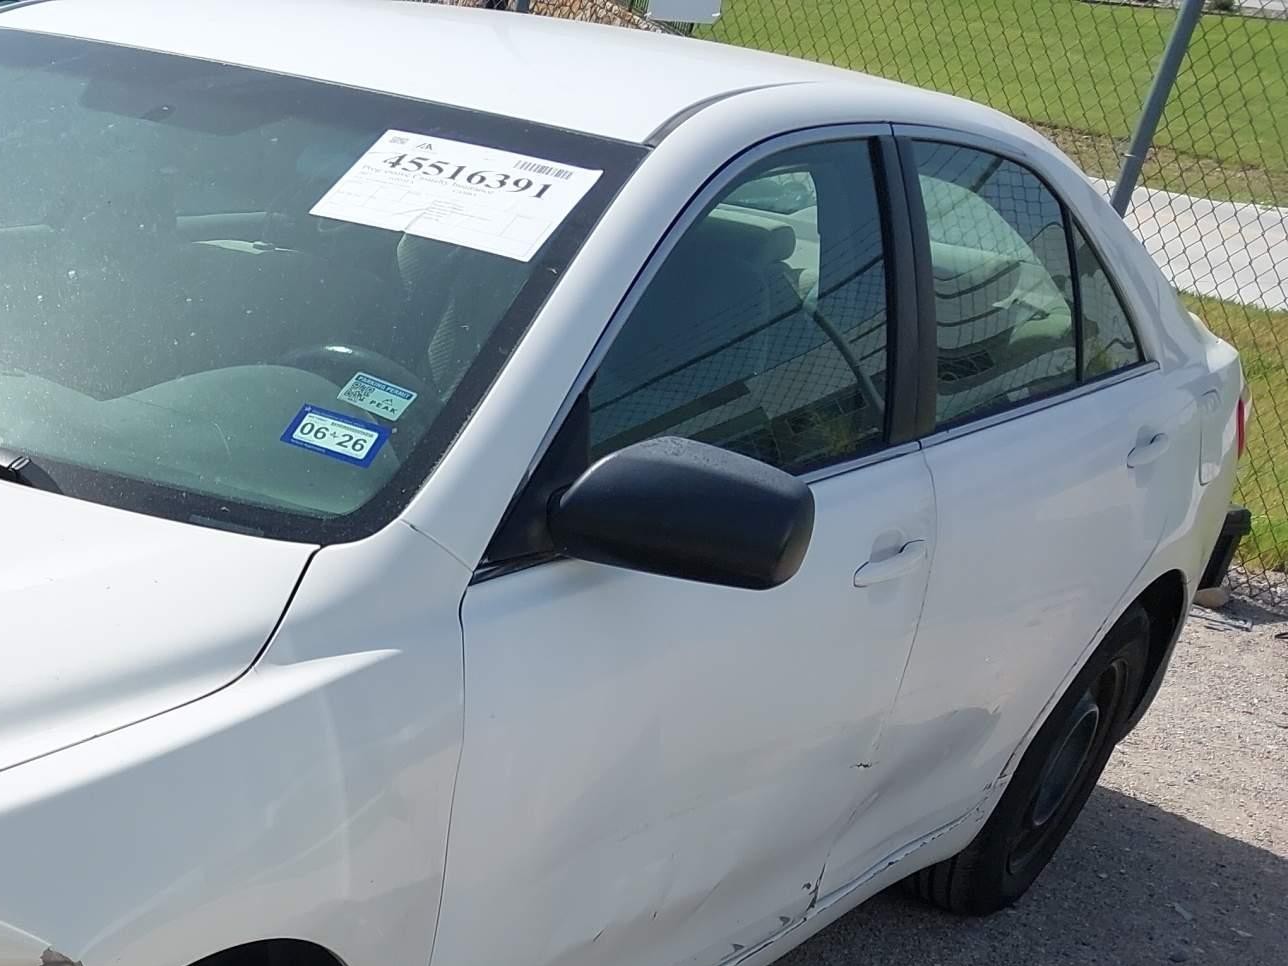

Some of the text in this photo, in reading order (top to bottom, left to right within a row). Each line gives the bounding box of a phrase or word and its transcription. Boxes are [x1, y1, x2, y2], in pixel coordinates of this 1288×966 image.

[383, 153, 552, 200] 45516391
[369, 400, 398, 414] PEAK
[300, 422, 329, 440] 06
[336, 433, 367, 452] 26
